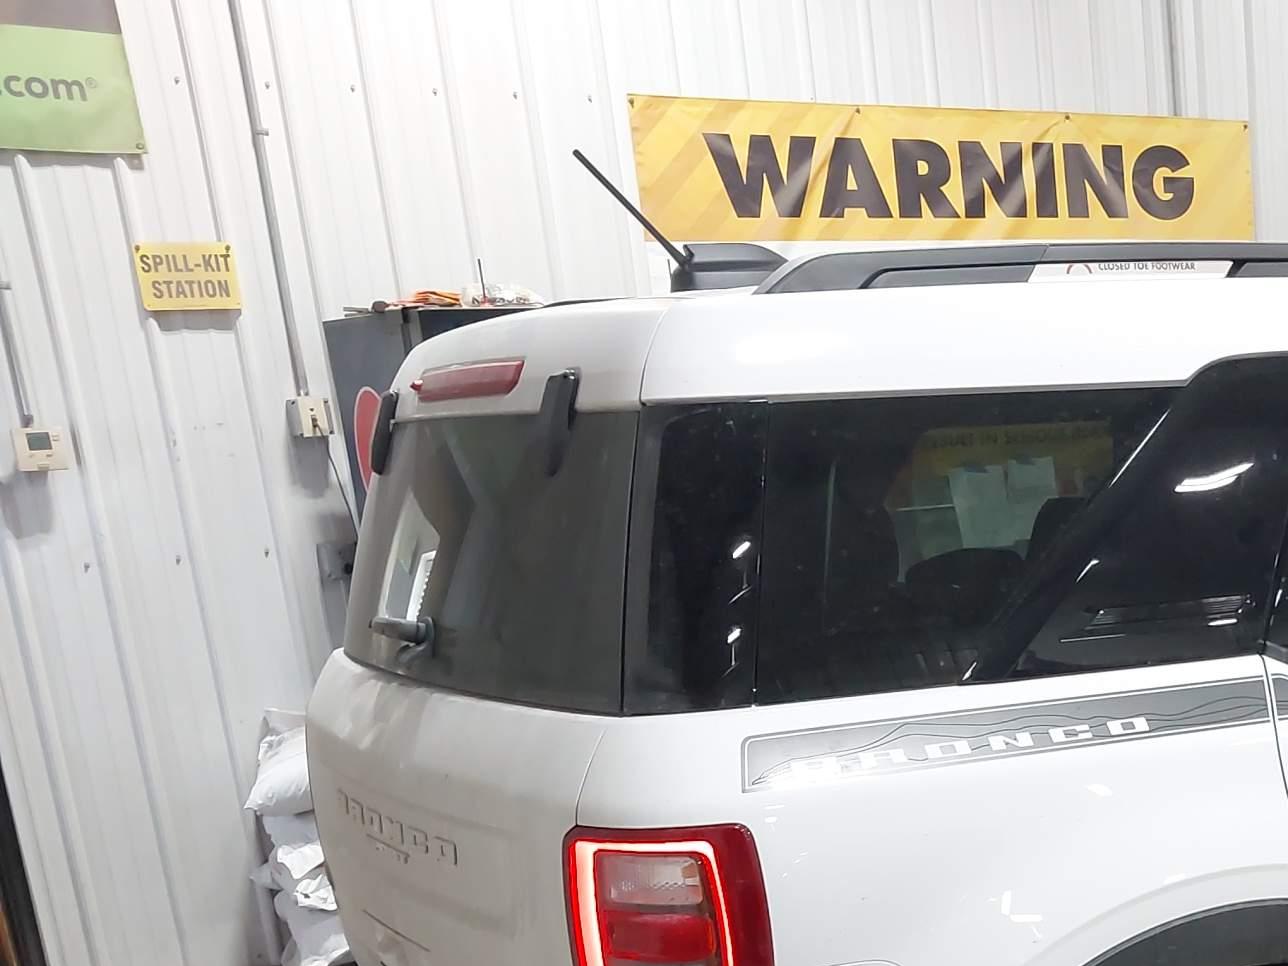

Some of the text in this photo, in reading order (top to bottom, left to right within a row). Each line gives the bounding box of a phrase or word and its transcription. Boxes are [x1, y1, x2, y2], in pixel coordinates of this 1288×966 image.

[702, 132, 1195, 220] WARNING
[140, 253, 230, 273] SPILL-KIT
[1151, 262, 1196, 270] FOOTWEAR
[151, 279, 231, 299] STATION
